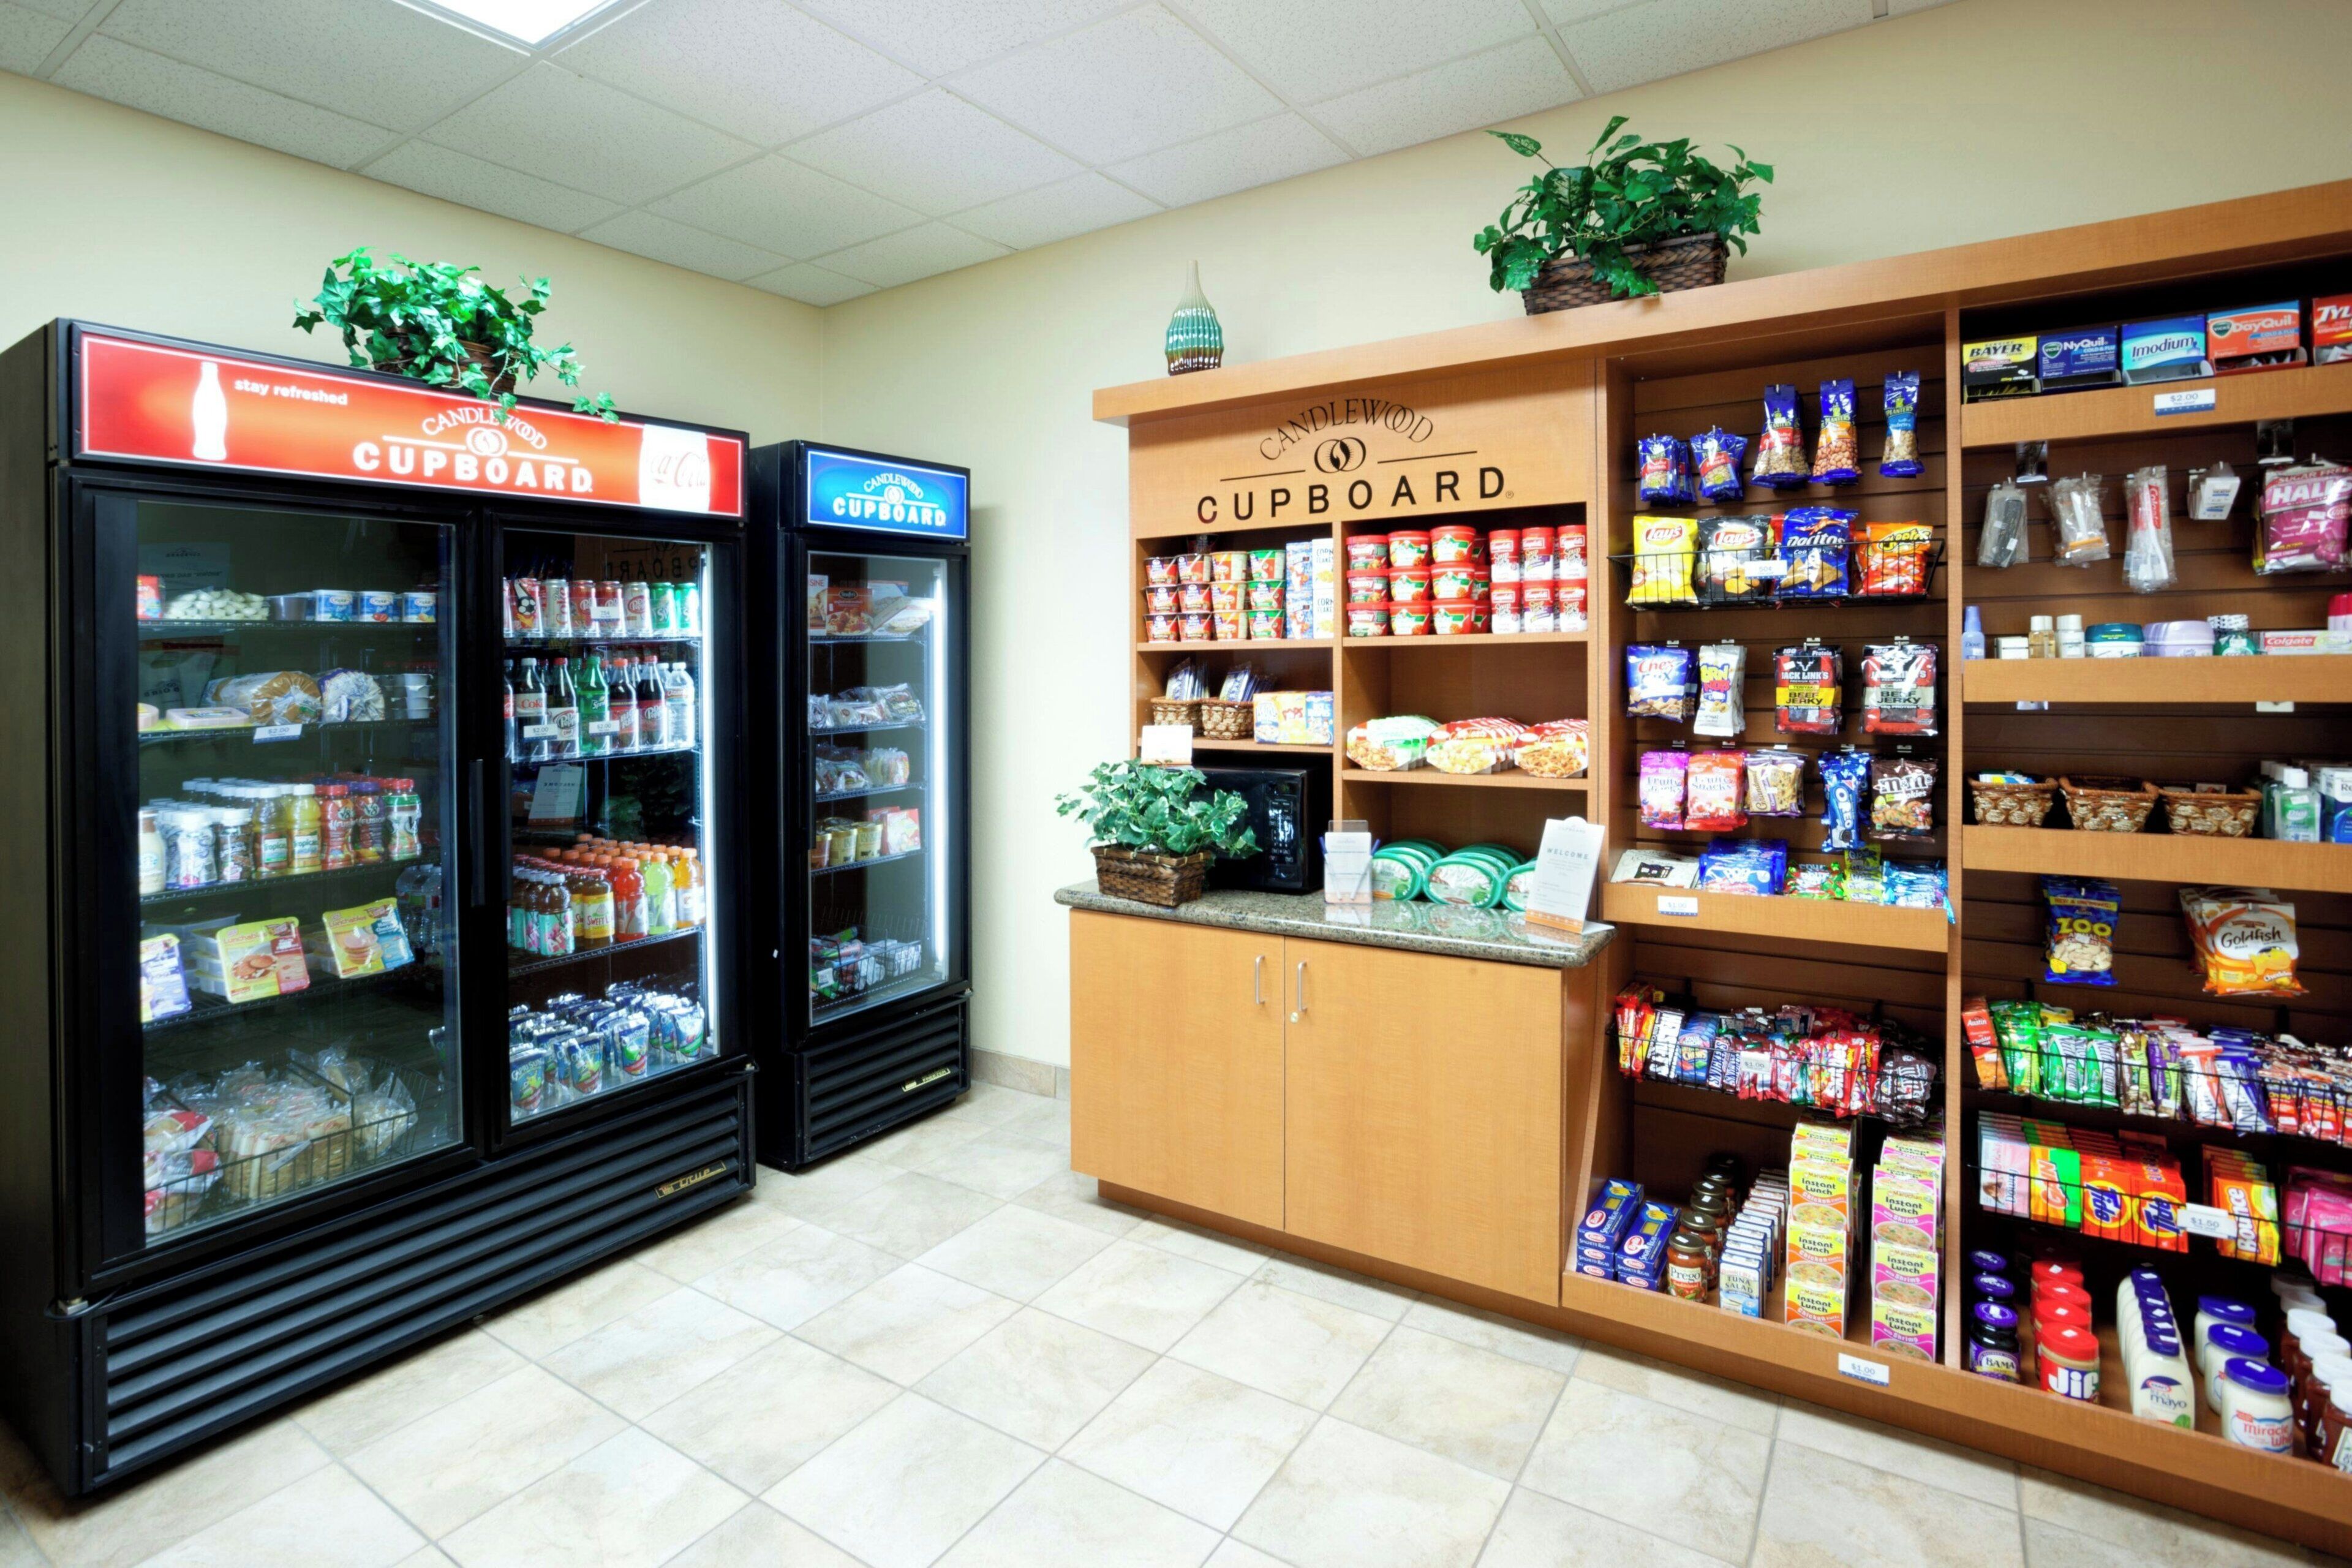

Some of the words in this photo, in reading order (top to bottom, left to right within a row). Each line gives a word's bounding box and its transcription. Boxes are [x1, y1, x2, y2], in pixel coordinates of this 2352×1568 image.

[2232, 315, 2292, 333] DayQuil
[1969, 343, 2022, 357] BAYER
[2064, 337, 2105, 351] NyQuil
[2132, 336, 2194, 357] Imodium
[235, 379, 269, 396] stay
[273, 383, 349, 406] refreshed
[2169, 393, 2198, 402] $2.00
[1259, 398, 1434, 461] CANDLEWOOD
[352, 442, 592, 492] CUPBOARD
[863, 473, 924, 500] CANDLEWOOD
[1197, 466, 1506, 524] CUPBOARD
[832, 497, 947, 527] CUPBOARD
[1787, 532, 1846, 549] Doritos
[2267, 636, 2313, 646] Colgate
[1547, 848, 1589, 860] WELCOME
[2056, 918, 2112, 936] ZOO
[2220, 926, 2282, 948] Goldfish
[1801, 1178, 1836, 1190] Instant
[1806, 1185, 1833, 1196] Lunch
[1885, 1196, 1923, 1210] Instant
[1890, 1204, 1919, 1216] Lunch
[2191, 1217, 2220, 1228] $1.50
[2227, 1188, 2260, 1253] Bounce
[1798, 1236, 1833, 1249] Instant
[1803, 1243, 1830, 1254] Lunch
[1887, 1256, 1924, 1268] Instant
[1670, 1266, 1702, 1283] Prego
[1891, 1264, 1920, 1275] Lunch
[1727, 1275, 1751, 1286] TUNA
[1725, 1282, 1754, 1294] SALAD
[1797, 1294, 1832, 1308] Instant
[1801, 1302, 1828, 1313] Lunch
[1885, 1314, 1922, 1329] Instant
[1889, 1322, 1918, 1334] Lunch
[1851, 1363, 1875, 1375] $1.00
[1986, 1357, 2016, 1370] BAMA
[2048, 1366, 2099, 1399] Jif
[2150, 1393, 2187, 1409] mayo
